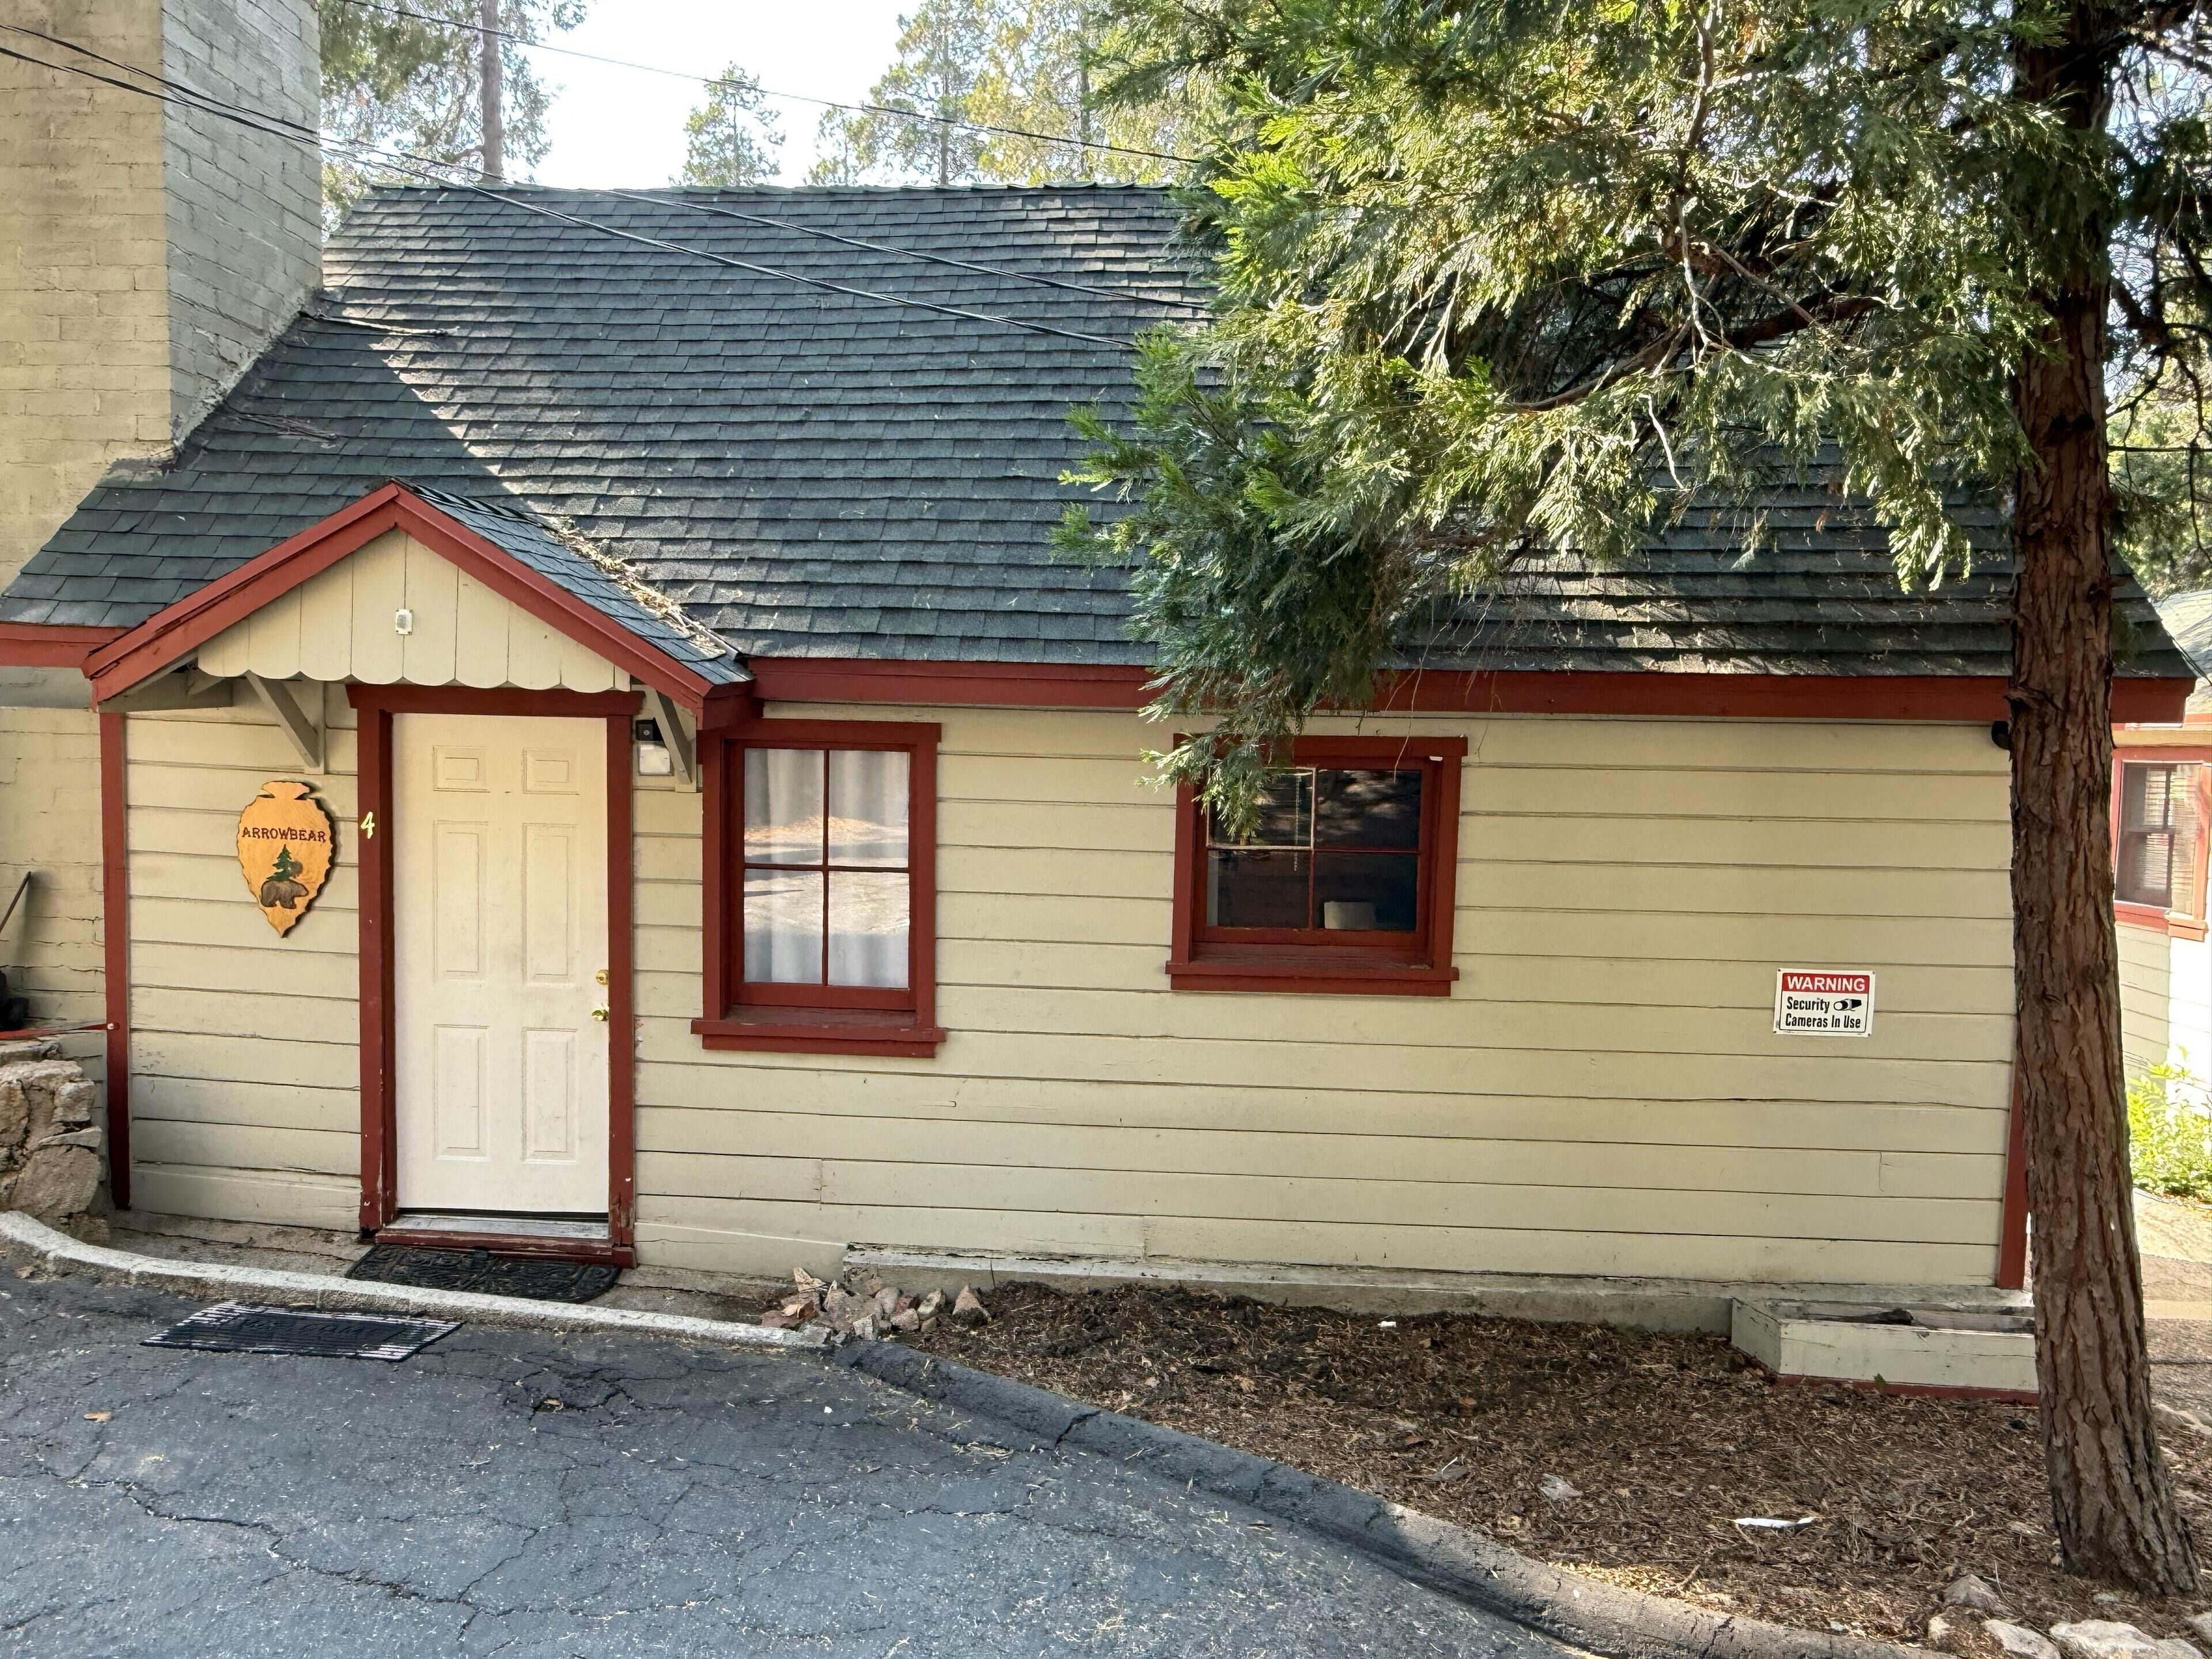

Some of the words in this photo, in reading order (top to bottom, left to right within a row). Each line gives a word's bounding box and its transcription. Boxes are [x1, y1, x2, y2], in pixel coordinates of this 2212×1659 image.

[360, 811, 375, 839] 4
[241, 827, 327, 843] ARROWBEAR
[1787, 975, 1865, 992] WARNING
[1786, 996, 1830, 1014] Security
[1785, 1013, 1828, 1028] Cameras
[1831, 1015, 1840, 1028] In
[1843, 1015, 1861, 1028] Use
